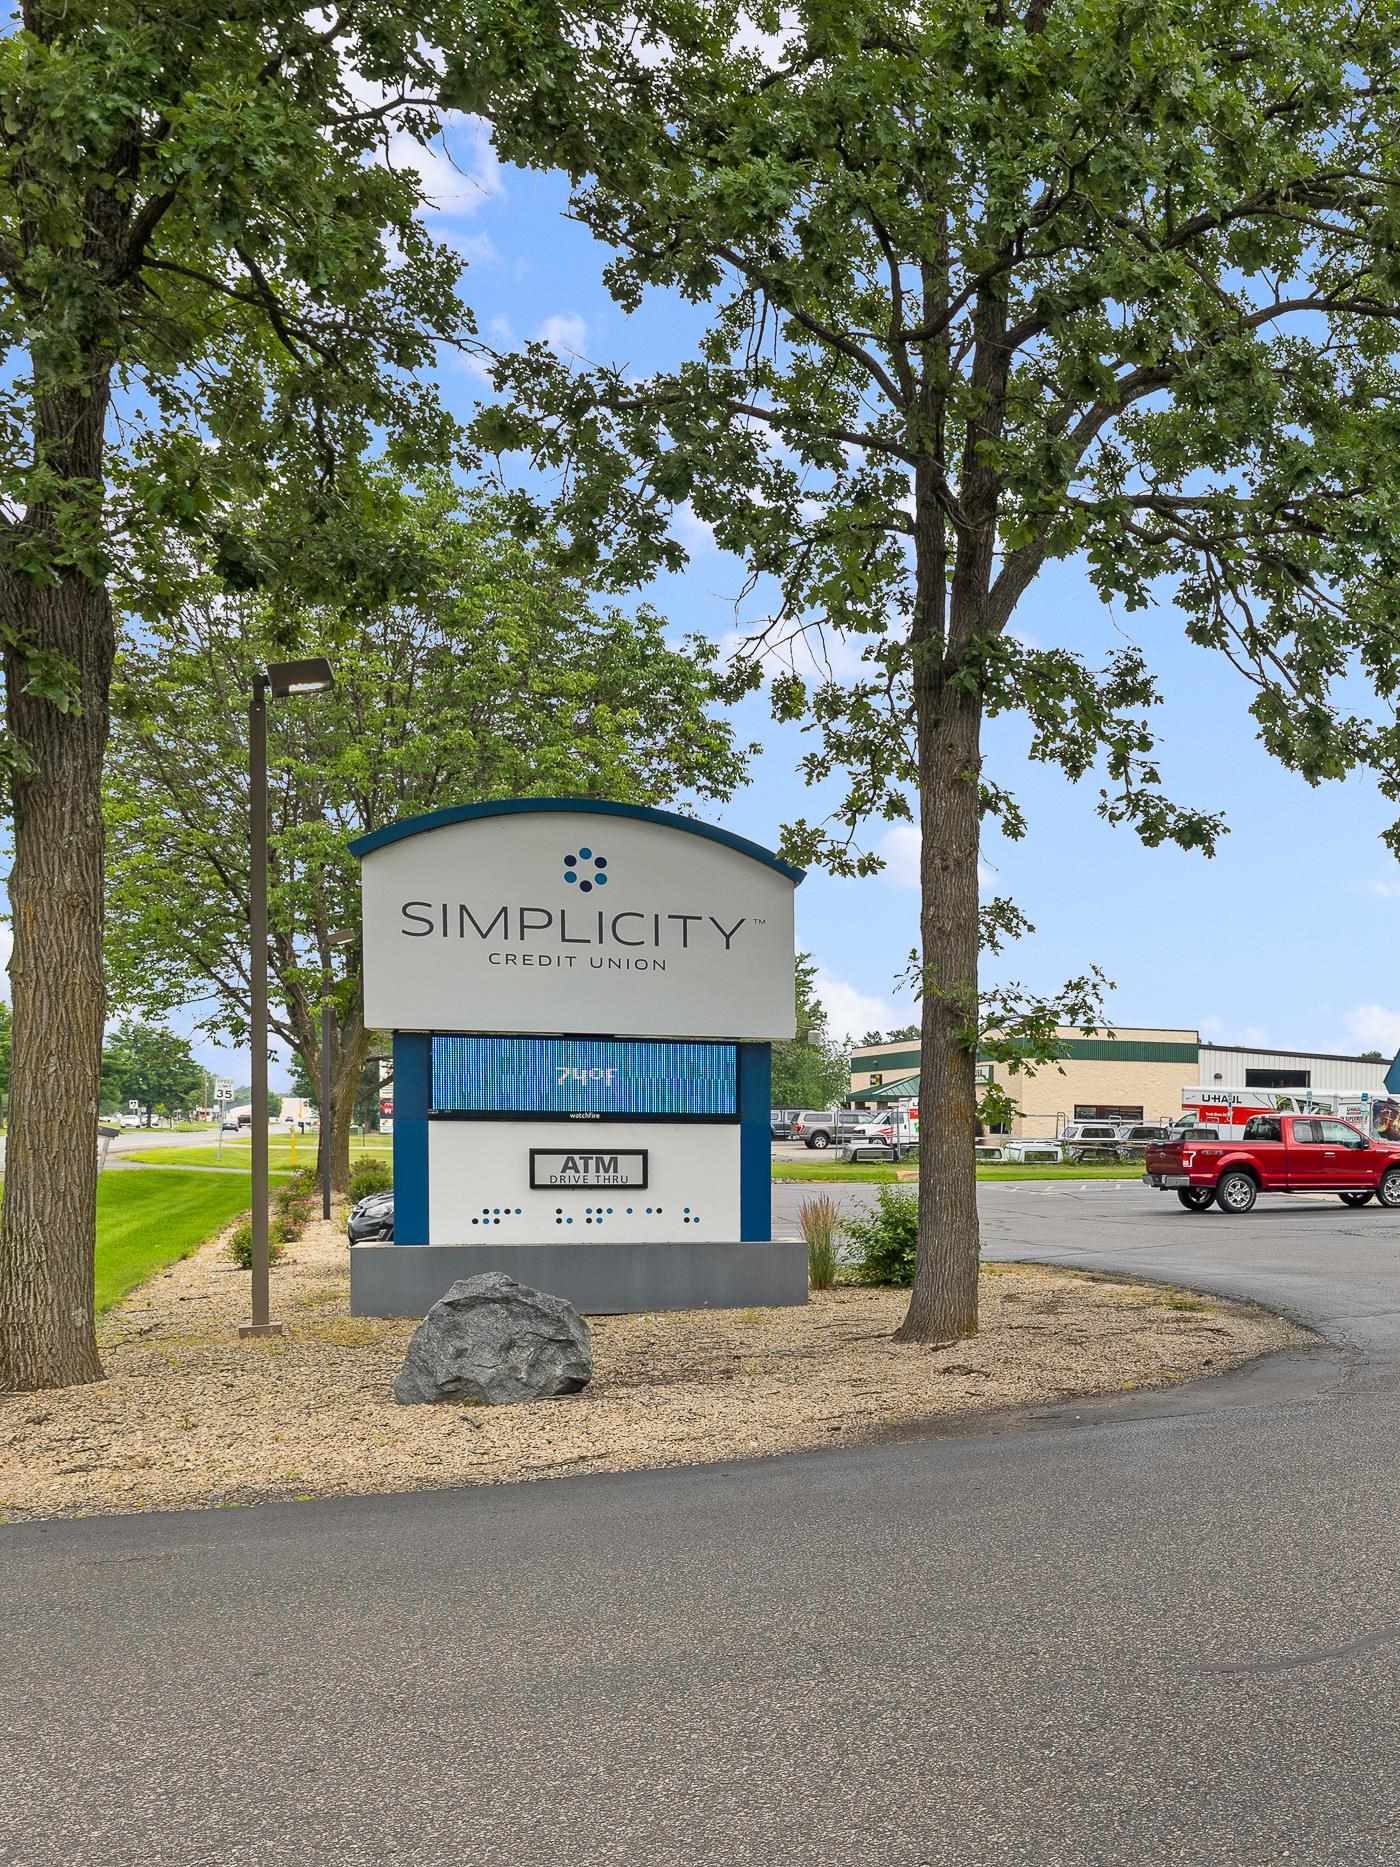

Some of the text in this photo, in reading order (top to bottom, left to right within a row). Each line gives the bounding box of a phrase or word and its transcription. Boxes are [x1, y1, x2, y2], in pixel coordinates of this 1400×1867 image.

[401, 901, 747, 950] SIMPLICITY
[488, 952, 667, 972] CREDIT UNION
[216, 1090, 232, 1099] 35
[1201, 1094, 1242, 1104] U-HAUL
[560, 1156, 618, 1174] ATM
[549, 1175, 629, 1184] DRIVE THRU
